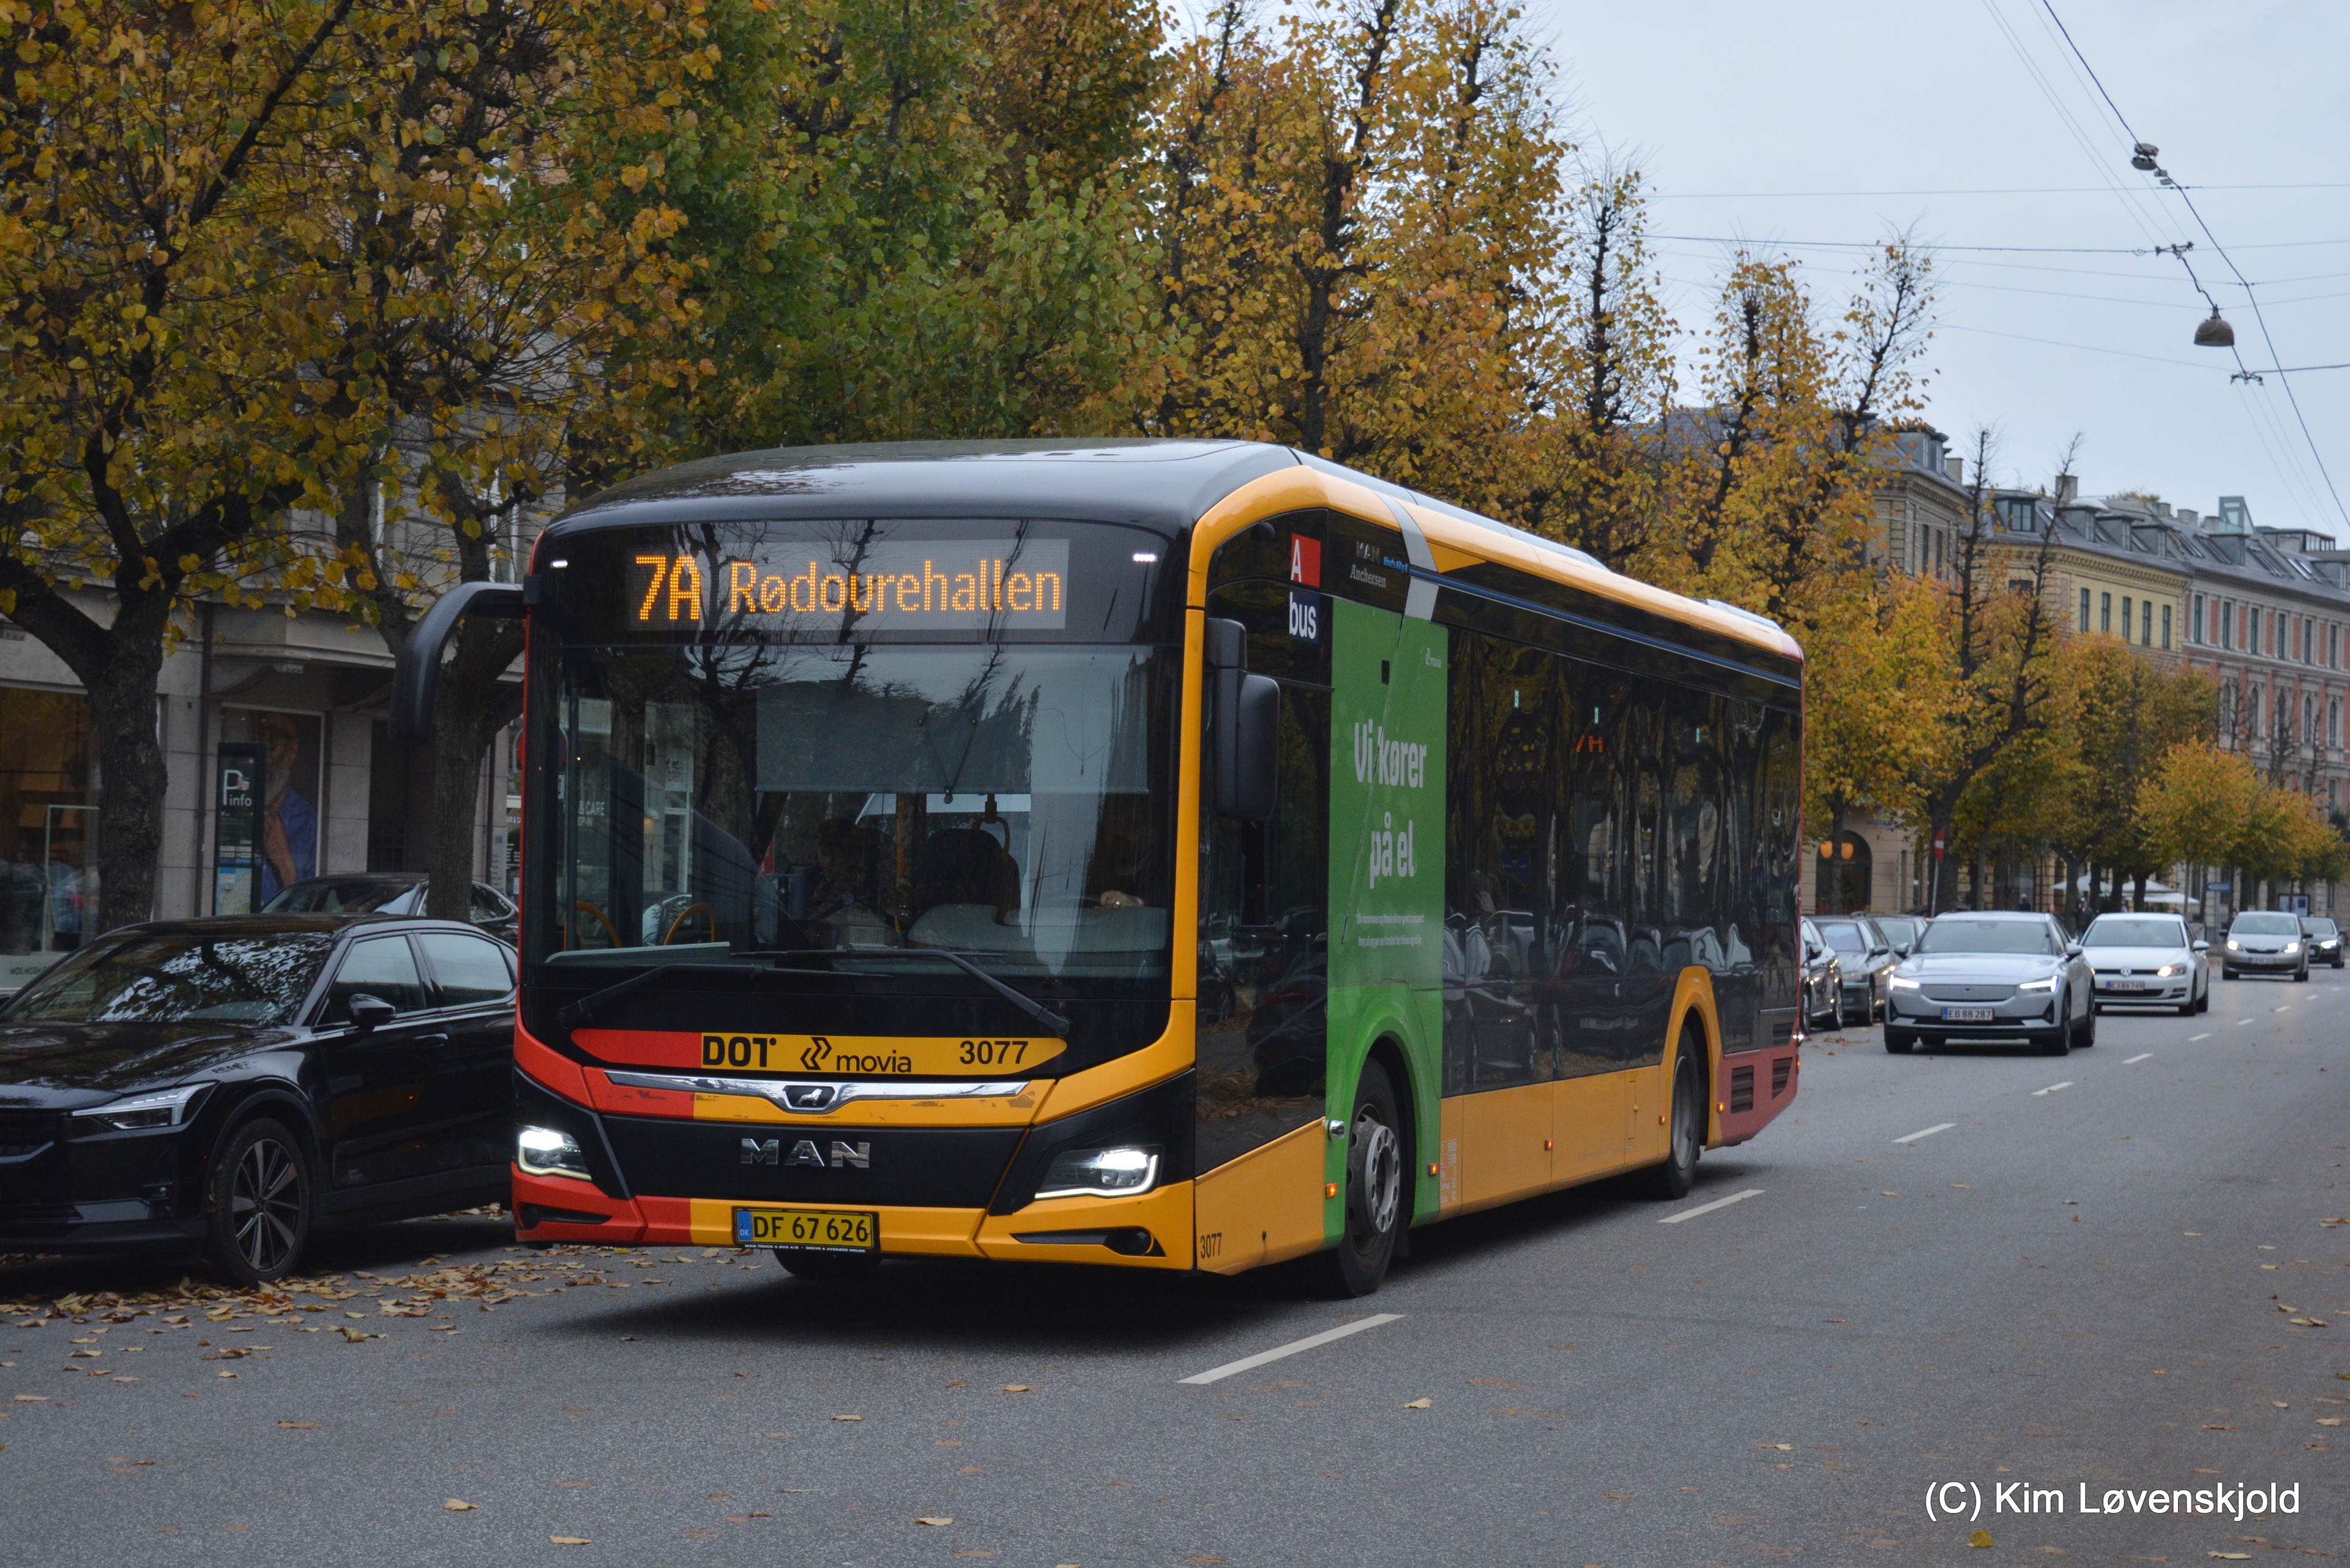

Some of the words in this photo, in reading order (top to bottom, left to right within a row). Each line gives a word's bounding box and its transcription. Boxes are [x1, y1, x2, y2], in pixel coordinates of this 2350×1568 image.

[1291, 539, 1302, 583] A
[1356, 541, 1381, 564] MAN
[635, 555, 701, 620] 7A
[1350, 564, 1387, 588] Anchersen
[1289, 592, 1316, 640] bus
[1354, 719, 1373, 783] Vi
[1378, 726, 1427, 789] kører
[229, 794, 252, 807] info
[586, 801, 605, 816] CARE
[1370, 812, 1393, 889] på
[1397, 820, 1415, 878] el
[1975, 1010, 1991, 1018] 287
[702, 1036, 776, 1068] DOT
[836, 1050, 911, 1073] movia
[959, 1040, 1028, 1064] 3077
[740, 1138, 870, 1168] MAN
[753, 1216, 784, 1238] DF
[793, 1216, 819, 1239] 67
[827, 1217, 869, 1242] 626
[1199, 1233, 1222, 1260] 3077
